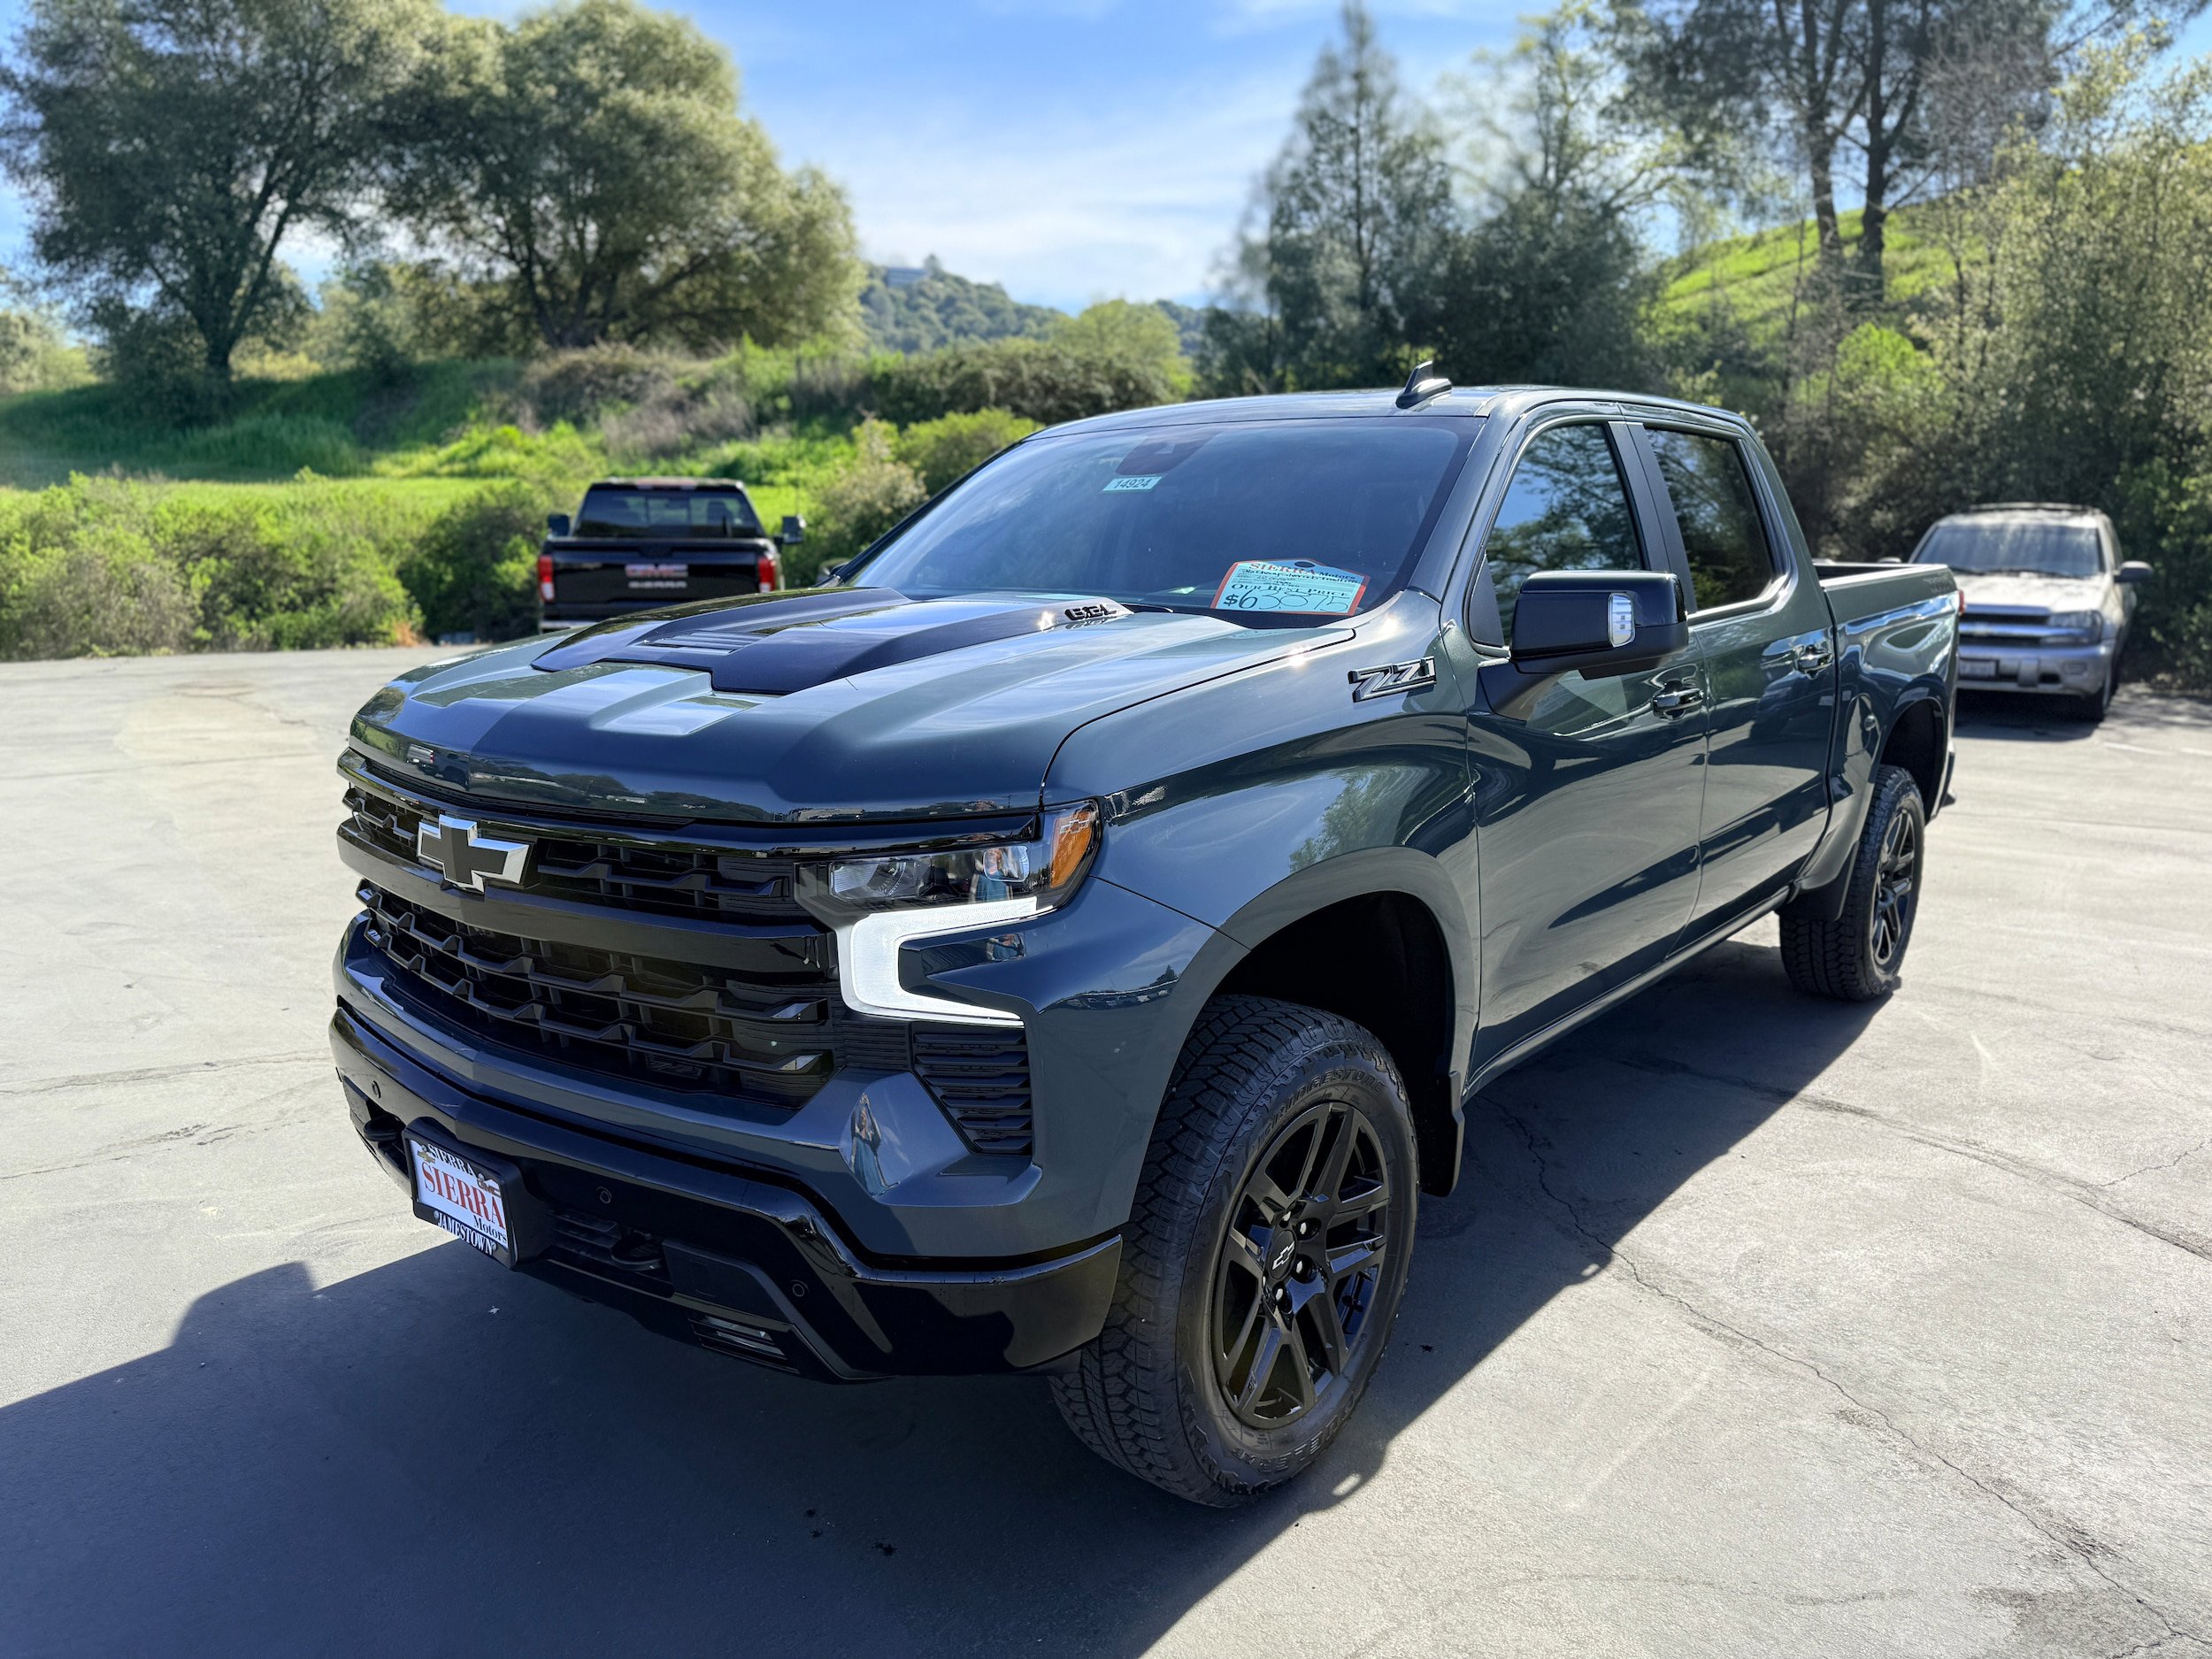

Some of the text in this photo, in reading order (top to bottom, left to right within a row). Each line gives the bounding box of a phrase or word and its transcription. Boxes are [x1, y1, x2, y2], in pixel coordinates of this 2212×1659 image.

[1113, 478, 1152, 488] 14924
[625, 564, 689, 578] GMC
[1248, 563, 1316, 574] SIERRA
[627, 580, 687, 589] SIERRA
[1348, 656, 1437, 703] Z71
[427, 1143, 476, 1178] SIERRA
[421, 1161, 506, 1229] SIERRA
[476, 1178, 501, 1198] GMC
[437, 1212, 495, 1256] JAMESTOWN
[473, 1215, 507, 1244] Motors
